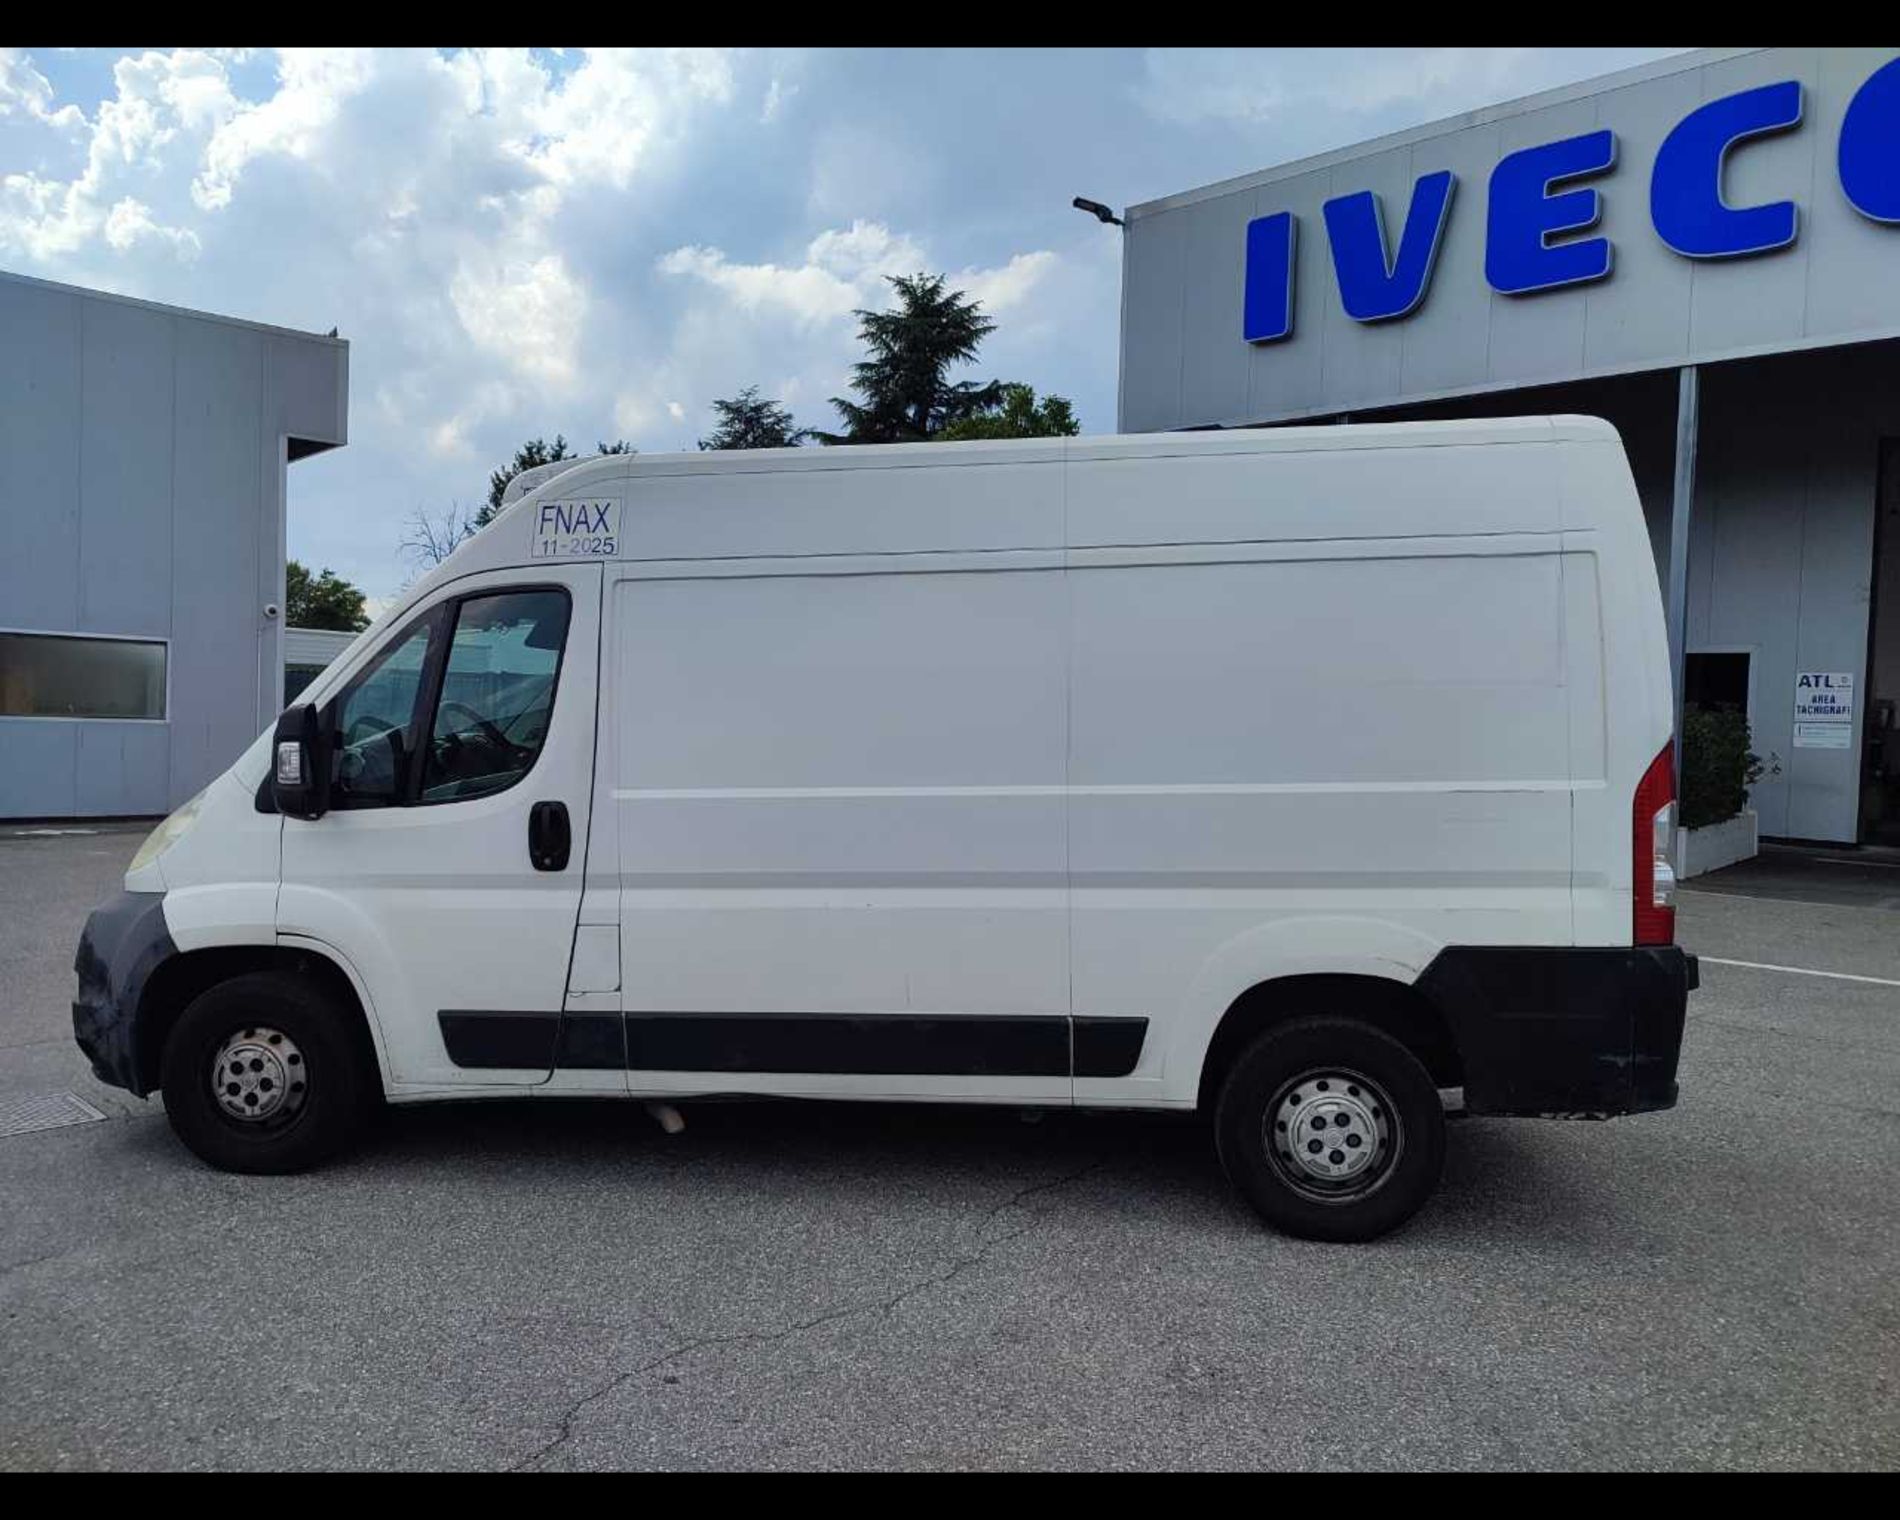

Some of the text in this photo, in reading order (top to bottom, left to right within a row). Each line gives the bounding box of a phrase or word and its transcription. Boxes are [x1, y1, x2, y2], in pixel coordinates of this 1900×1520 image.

[540, 502, 611, 535] FNAX
[1798, 674, 1834, 688] ATL
[1811, 694, 1836, 704] AREA
[1796, 705, 1851, 715] TACHIGRAFI
